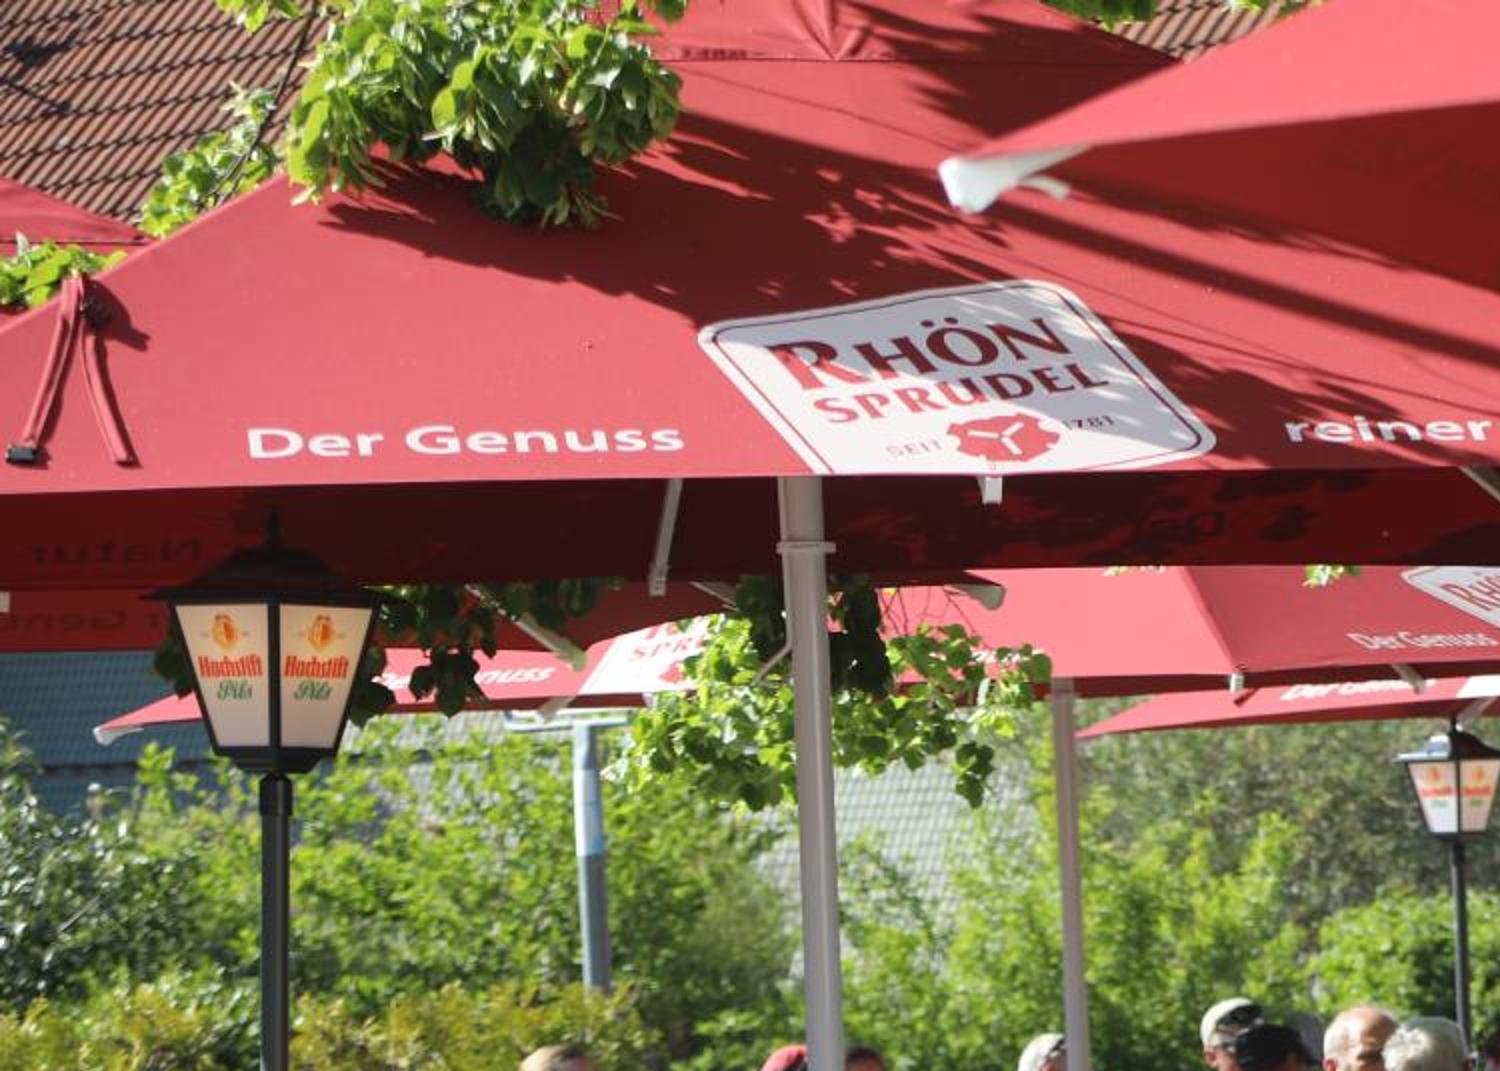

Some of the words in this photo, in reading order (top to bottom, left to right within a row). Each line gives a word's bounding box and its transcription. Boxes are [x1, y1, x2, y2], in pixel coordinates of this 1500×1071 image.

[765, 317, 1071, 391] RHÖN
[814, 363, 1109, 423] SPRUDEL
[247, 428, 384, 459] Der
[405, 425, 685, 455] Genuss
[1285, 415, 1492, 443] reiner
